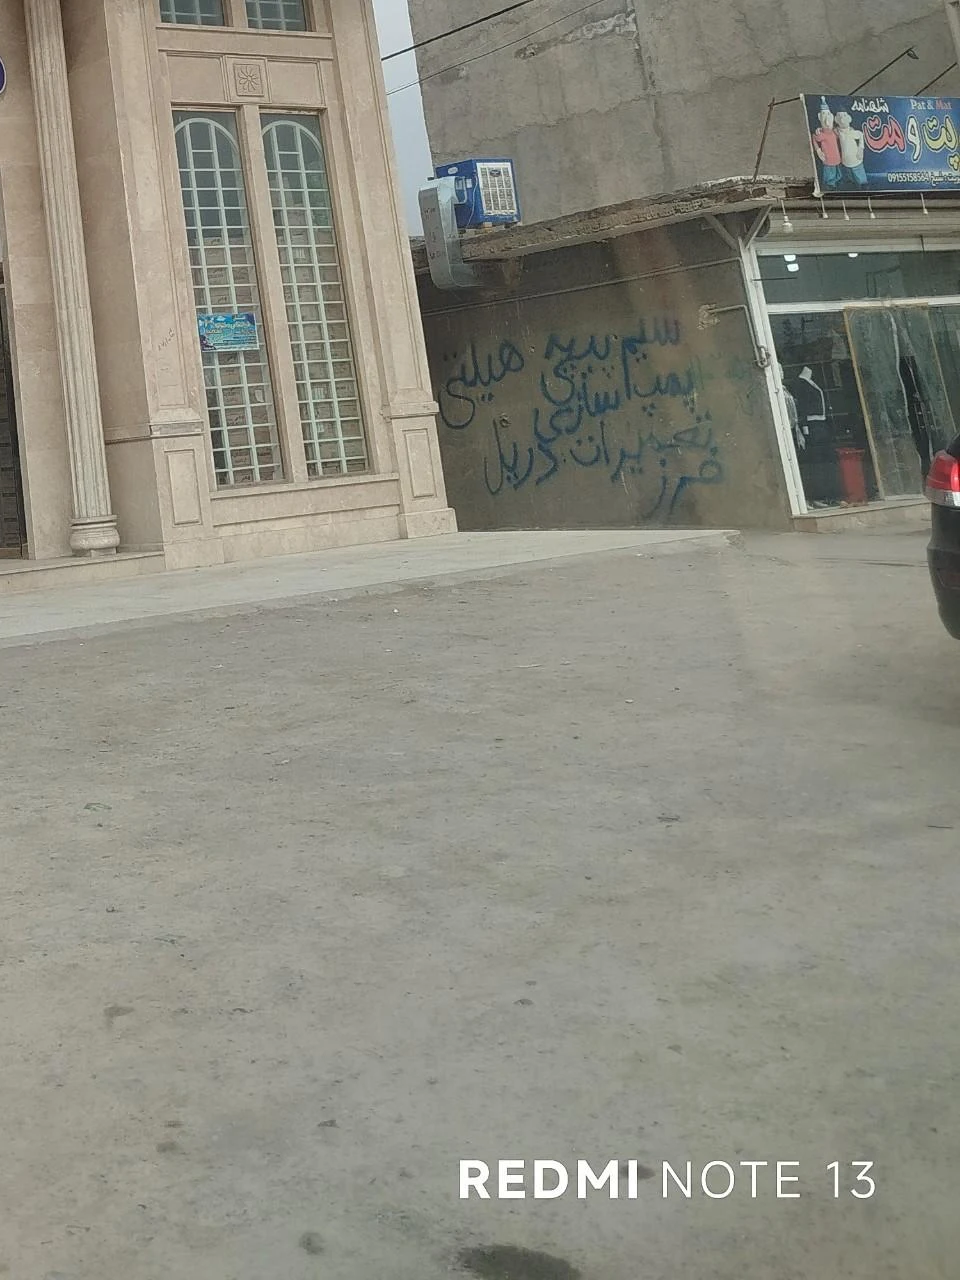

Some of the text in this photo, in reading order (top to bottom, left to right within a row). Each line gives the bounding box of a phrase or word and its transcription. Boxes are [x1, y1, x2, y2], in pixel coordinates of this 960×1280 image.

[910, 99, 952, 110] Pat & Mat
[862, 114, 960, 172] پت و مت
